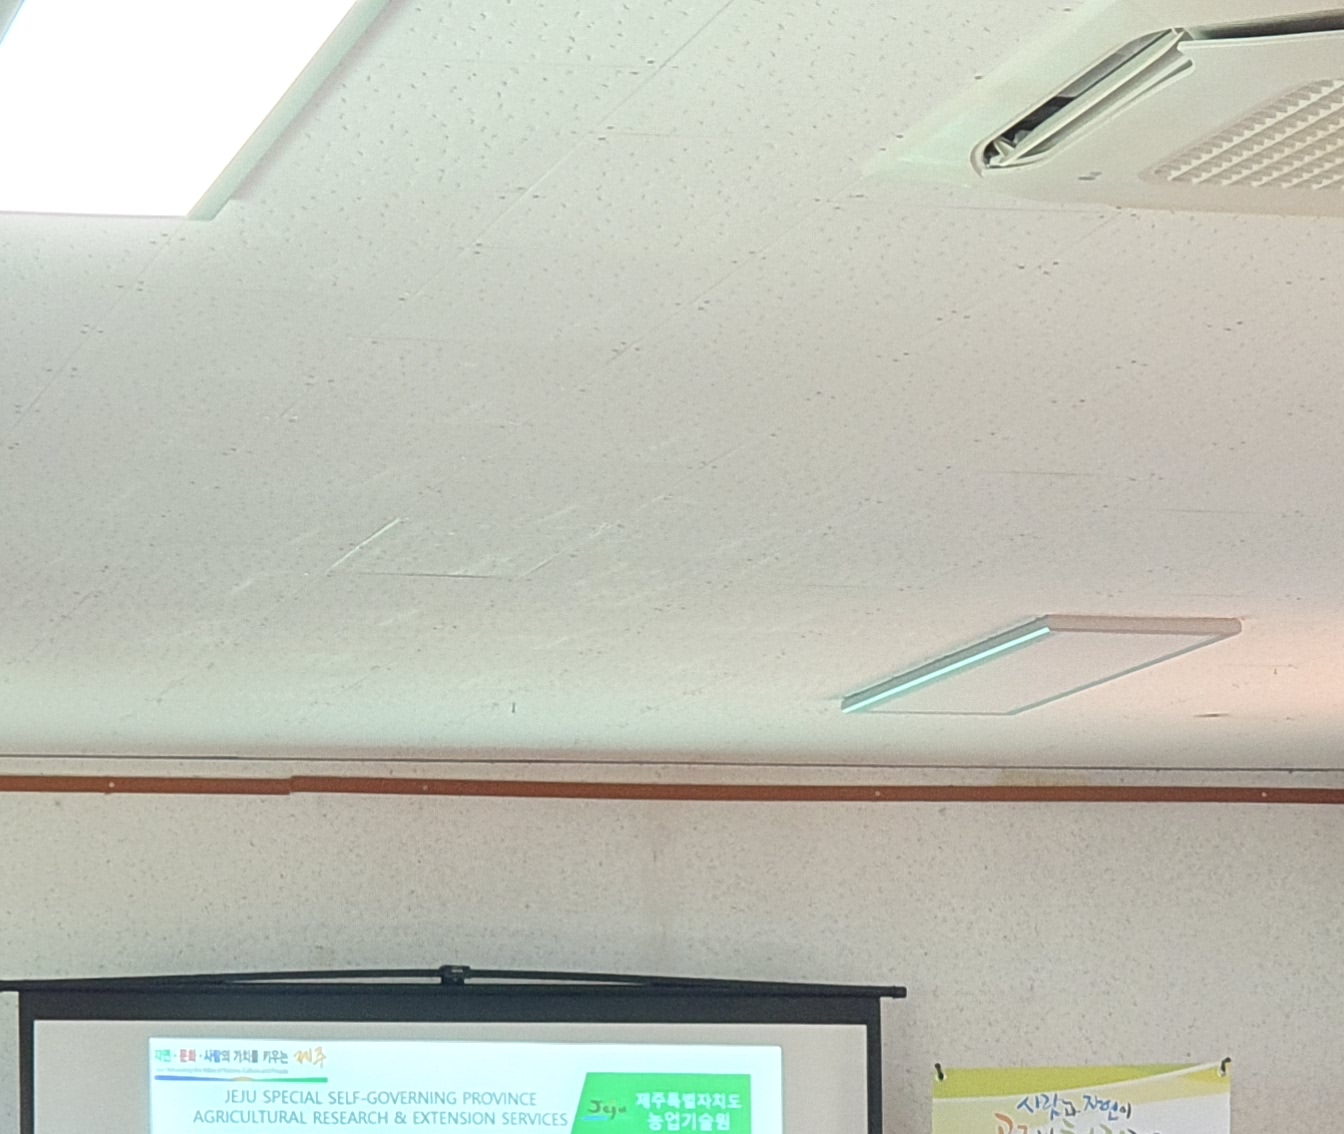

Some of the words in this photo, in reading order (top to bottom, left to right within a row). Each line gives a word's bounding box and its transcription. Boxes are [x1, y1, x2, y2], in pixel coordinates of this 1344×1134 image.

[225, 1089, 257, 1104] JEJU
[262, 1090, 323, 1105] SPECIAL
[328, 1090, 457, 1105] SELF-GOVERNING
[462, 1091, 537, 1106] PROVINCE
[635, 1091, 743, 1110] 제주특별자치도
[193, 1109, 308, 1125] AGRICULTURAL
[313, 1110, 389, 1125] RESEARCH
[394, 1111, 407, 1125] &
[413, 1111, 496, 1126] EXTENSION
[502, 1112, 568, 1127] SERVICES
[647, 1112, 732, 1132] 농업기술원
